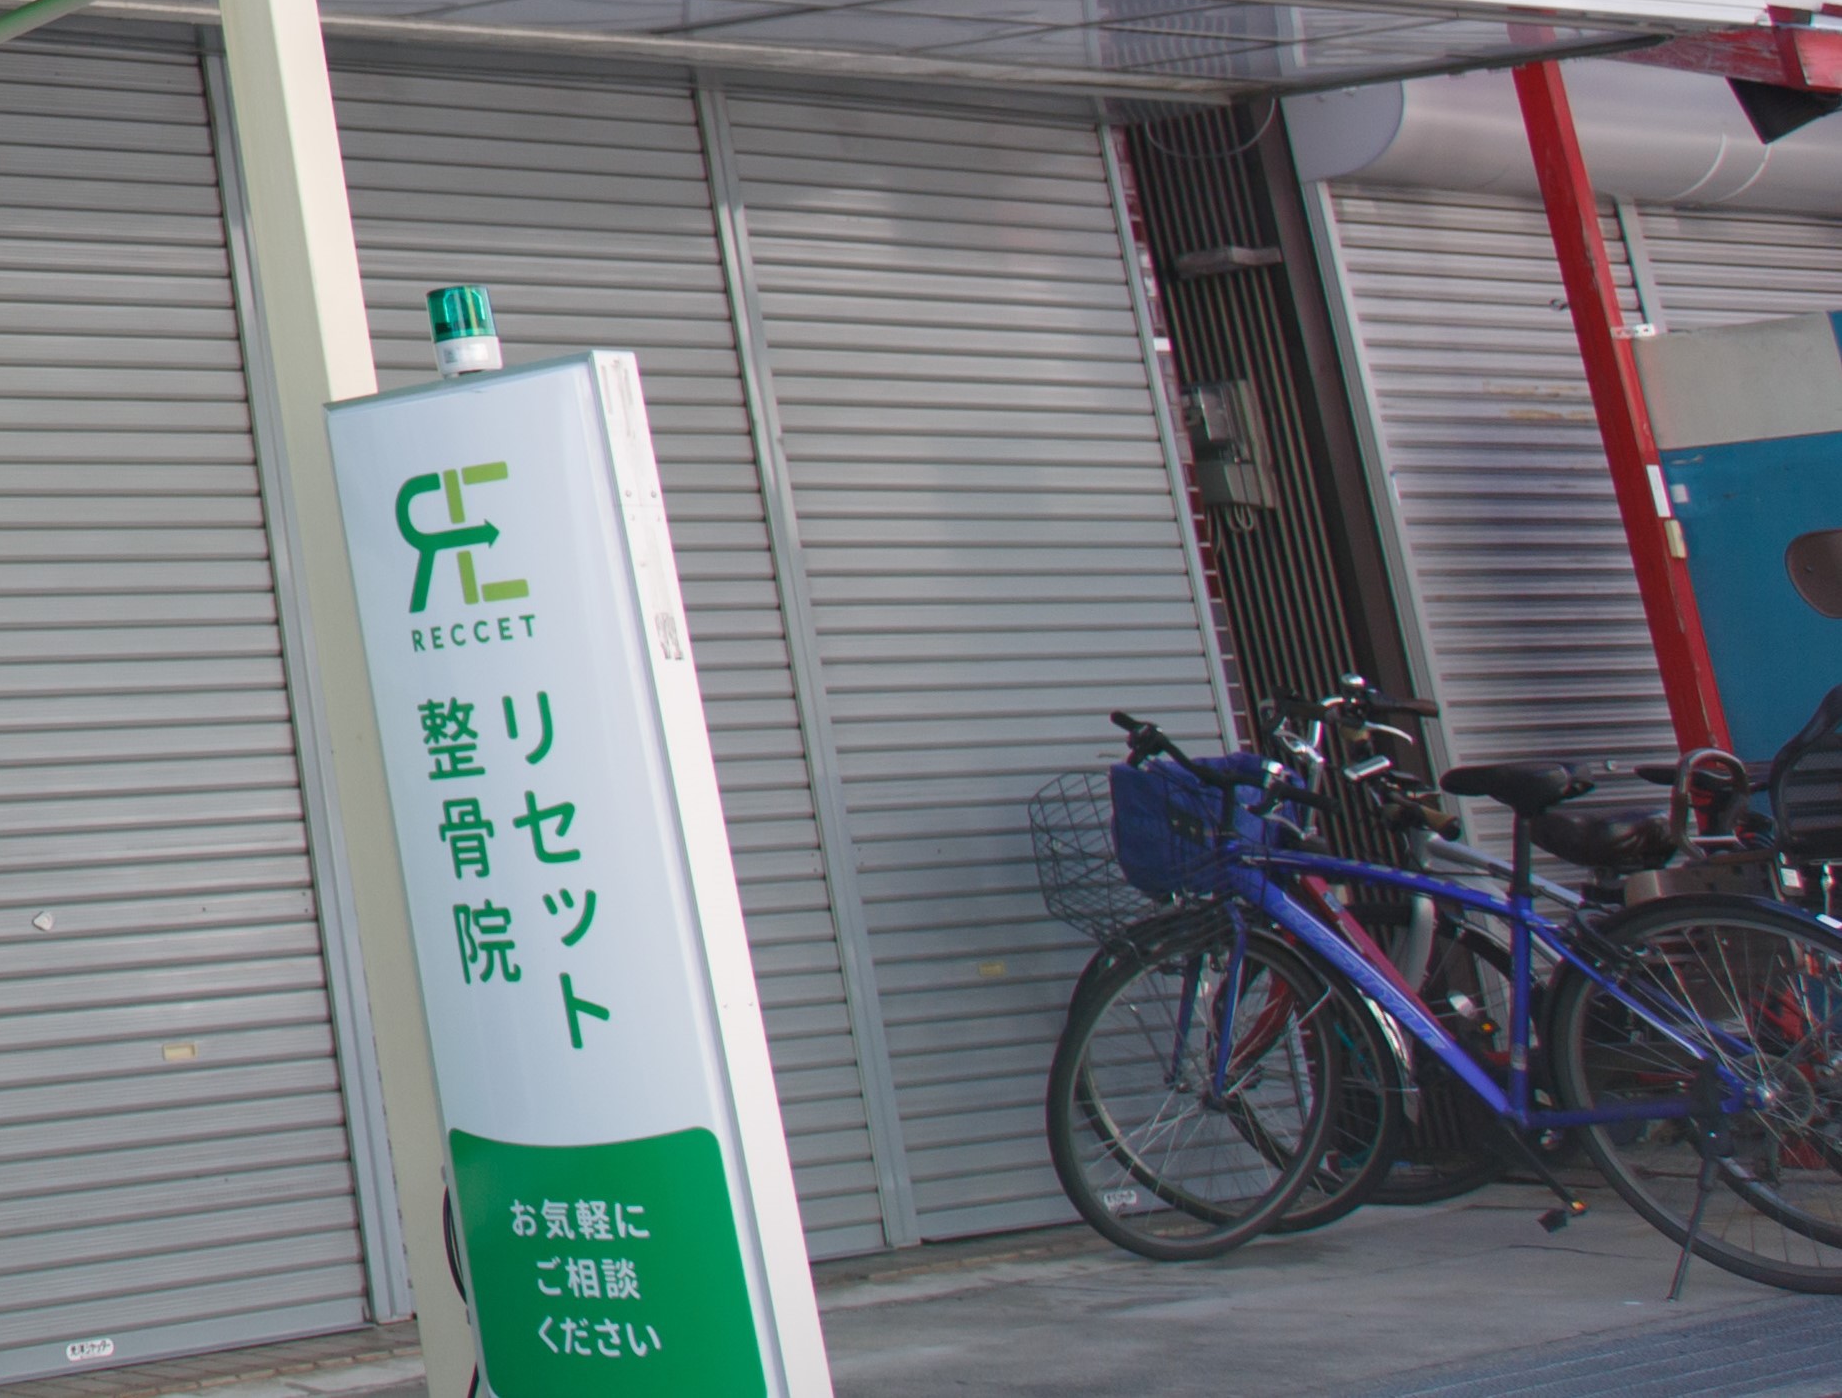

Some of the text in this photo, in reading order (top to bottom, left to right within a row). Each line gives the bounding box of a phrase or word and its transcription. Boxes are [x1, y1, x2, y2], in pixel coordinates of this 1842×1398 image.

[412, 614, 536, 652] RECCET
[418, 696, 522, 985] 整骨院
[502, 691, 611, 1049] リセット
[509, 1198, 650, 1240] お気軽に
[536, 1255, 641, 1299] ご相談
[537, 1315, 662, 1357] ください
